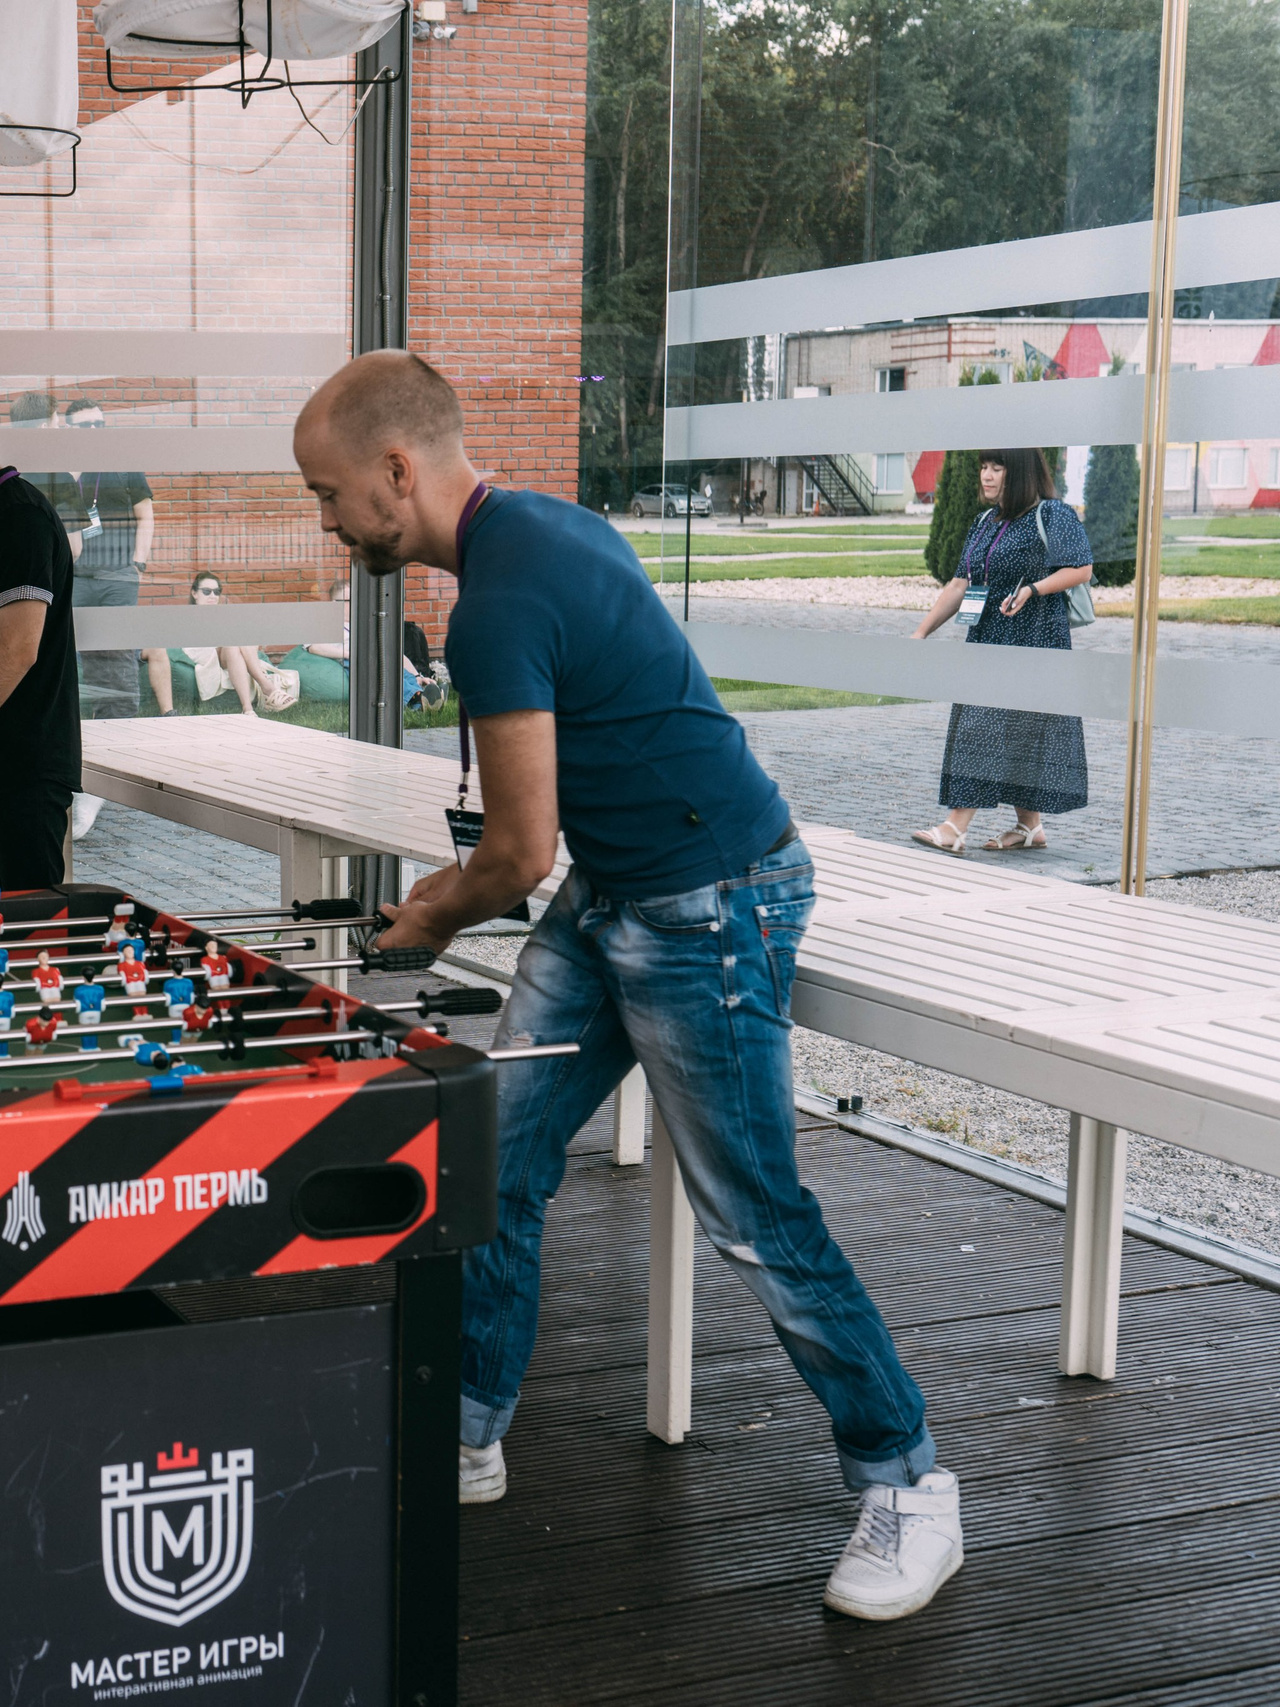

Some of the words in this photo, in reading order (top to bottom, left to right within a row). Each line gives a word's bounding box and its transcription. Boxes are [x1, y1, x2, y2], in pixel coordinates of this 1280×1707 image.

[67, 1176, 166, 1224] АМКАР
[173, 1167, 269, 1213] ПЕРМЬ
[70, 1645, 191, 1690] МАСТЕР
[199, 1631, 285, 1670] ИГРЫ
[93, 1674, 194, 1702] интерактивная
[196, 1664, 263, 1687] анимация
